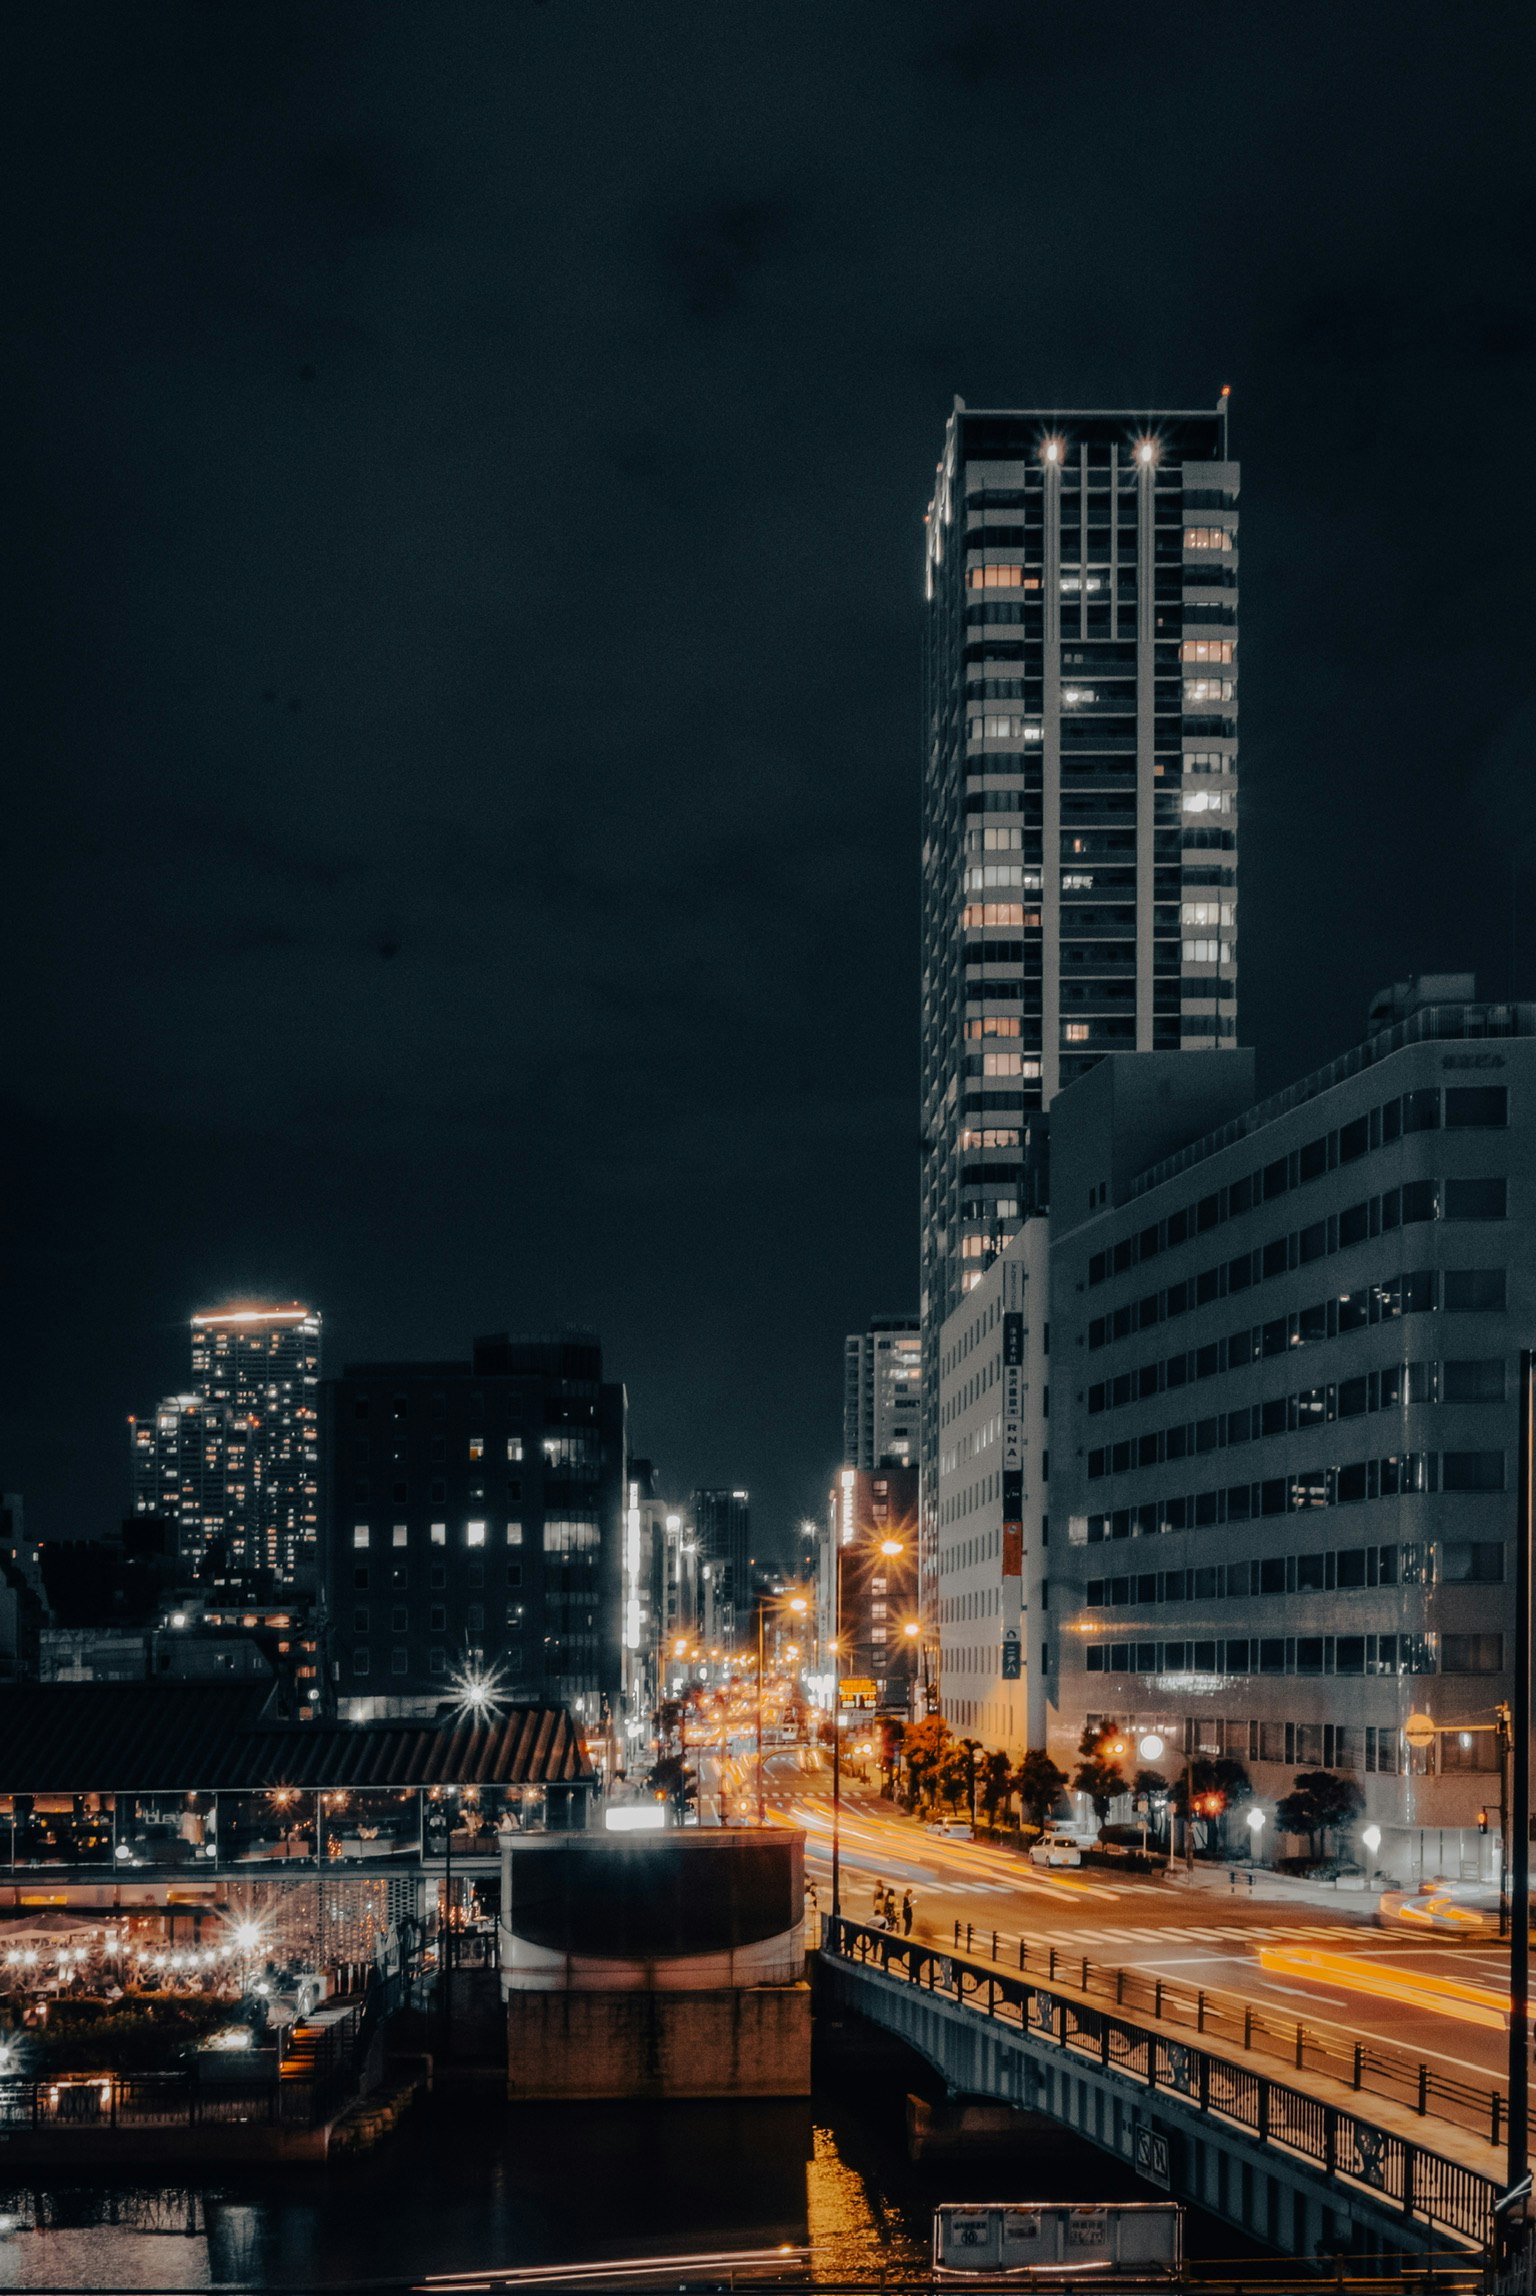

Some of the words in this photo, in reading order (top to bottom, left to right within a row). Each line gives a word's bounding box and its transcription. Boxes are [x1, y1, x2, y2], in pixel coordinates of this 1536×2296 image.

[1007, 1423, 1017, 1457] RNA
[1006, 1646, 1017, 1672] ニチハ
